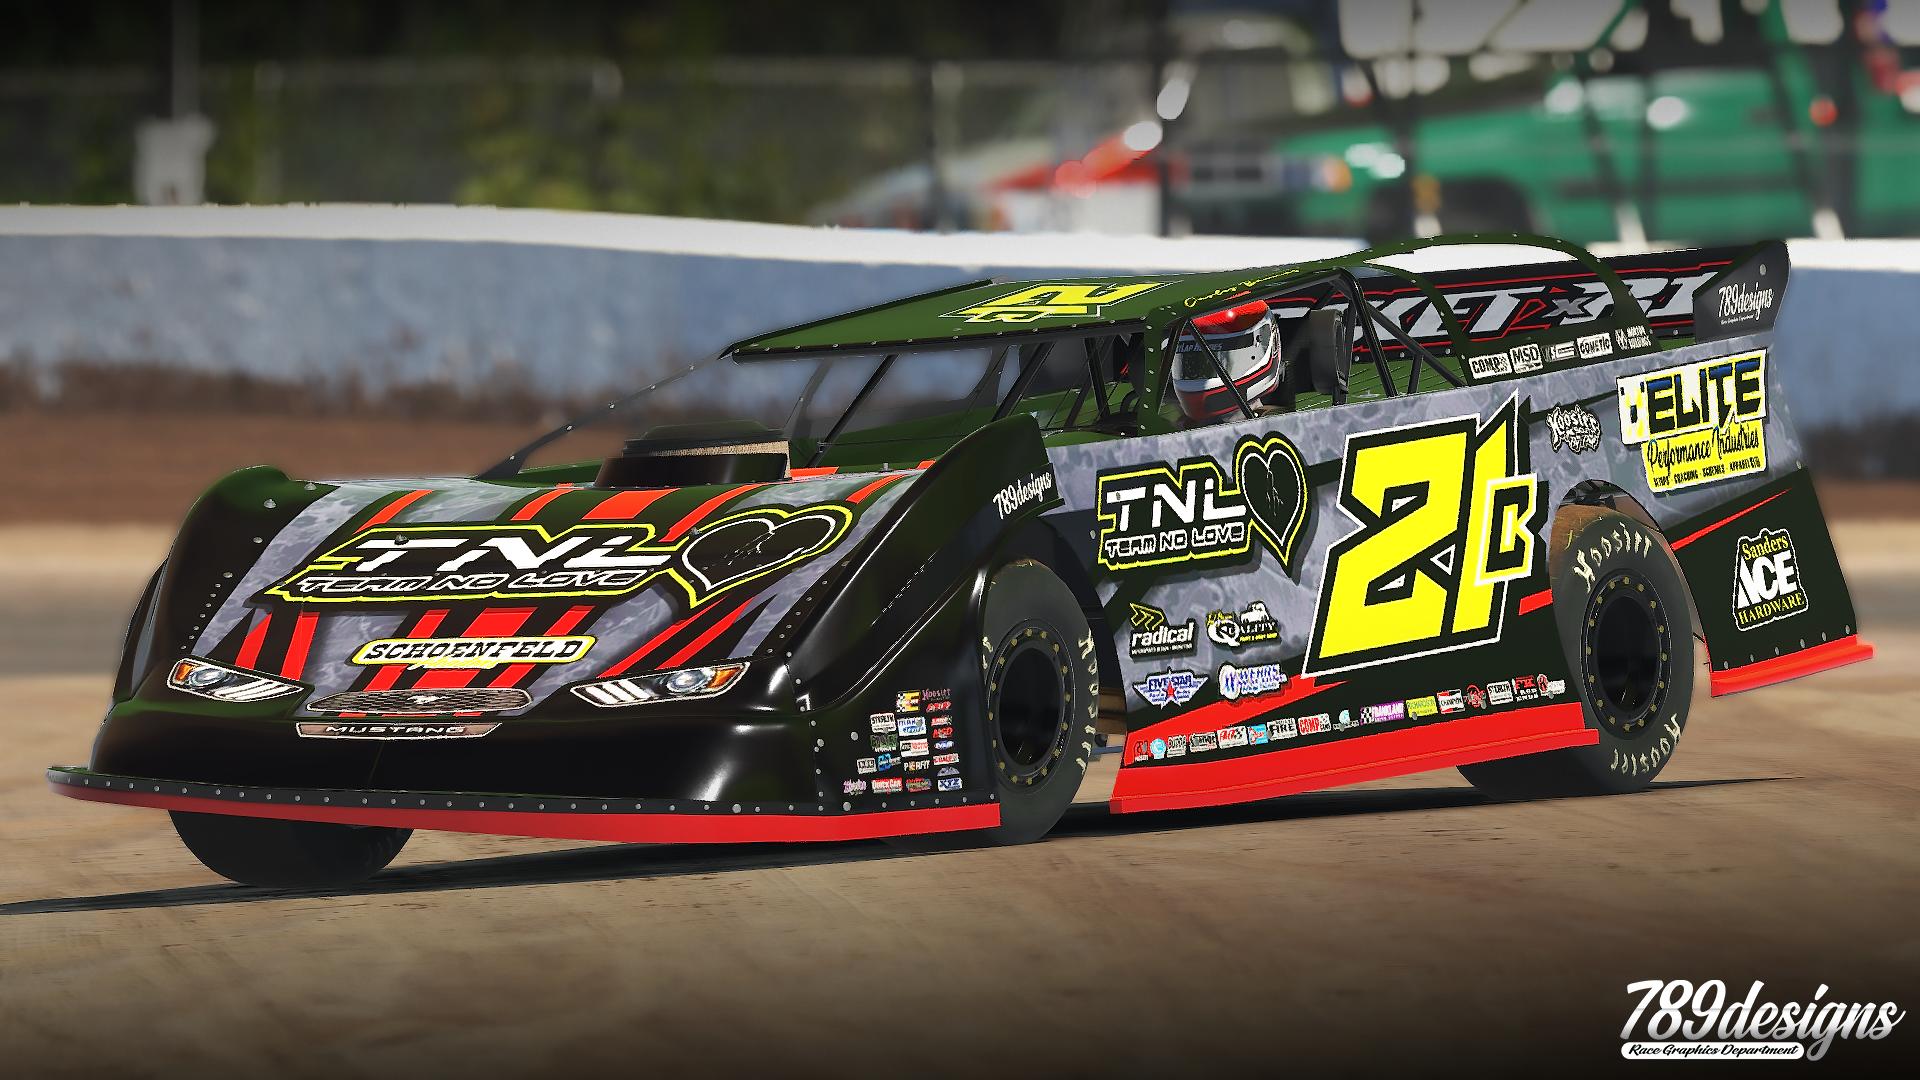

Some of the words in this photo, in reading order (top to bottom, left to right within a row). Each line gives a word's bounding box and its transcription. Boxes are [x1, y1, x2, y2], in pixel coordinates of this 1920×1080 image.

[1719, 282, 1774, 320] 789designs
[1512, 346, 1539, 362] MSD
[1647, 357, 1761, 434] ELITE
[1648, 438, 1711, 477] Performance
[1712, 425, 1760, 460] Industries
[992, 471, 1052, 520] 789designs
[1106, 476, 1247, 532] TNL
[356, 536, 671, 572] TNL
[1105, 534, 1156, 559] TEAM
[1160, 529, 1188, 552] NO
[1191, 522, 1245, 547] LOVE
[1741, 535, 1789, 560] Sanders
[297, 575, 431, 593] TEAM
[427, 573, 511, 591] NO
[507, 569, 647, 589] LOVE
[1737, 550, 1798, 609] ACE
[1738, 592, 1805, 625] HARDWARE
[363, 640, 585, 659] SCHOENFELD
[1131, 622, 1194, 647] radical
[325, 725, 466, 734] MUSTANG
